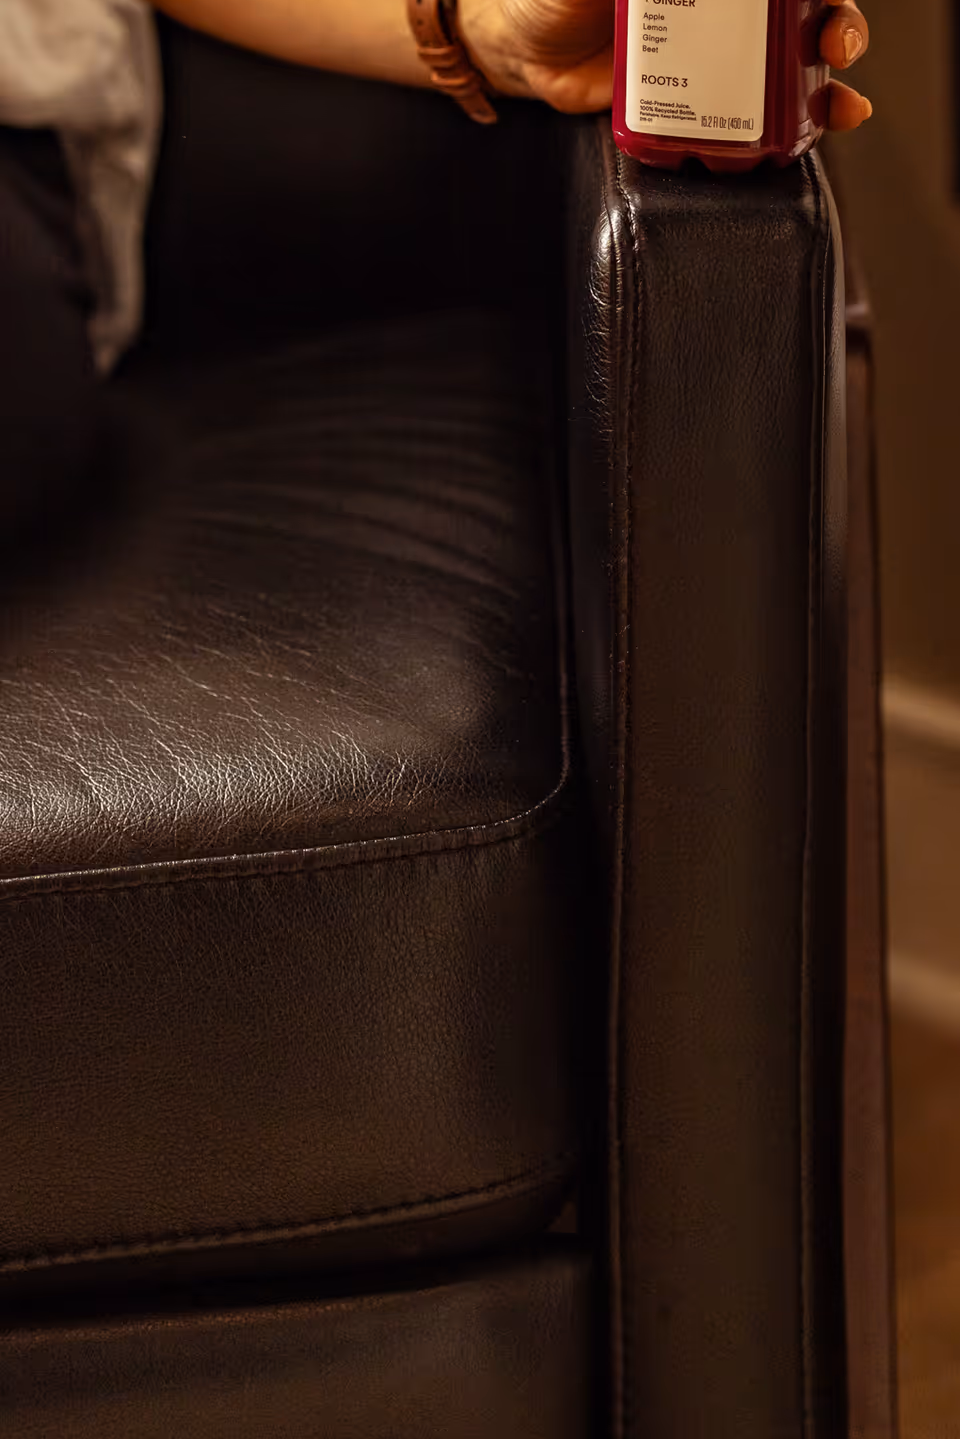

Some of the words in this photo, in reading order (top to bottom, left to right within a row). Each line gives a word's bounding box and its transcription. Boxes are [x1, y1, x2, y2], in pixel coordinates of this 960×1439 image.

[643, 12, 665, 22] Apple
[642, 23, 668, 32] Lemon
[642, 33, 668, 44] Ginger
[642, 44, 659, 54] Beet
[641, 74, 679, 87] ROOTS
[681, 77, 688, 88] 3
[640, 98, 675, 108] Cold-Pressed
[701, 115, 712, 128] 15.2
[719, 116, 727, 129] Oz
[727, 117, 742, 130] (450
